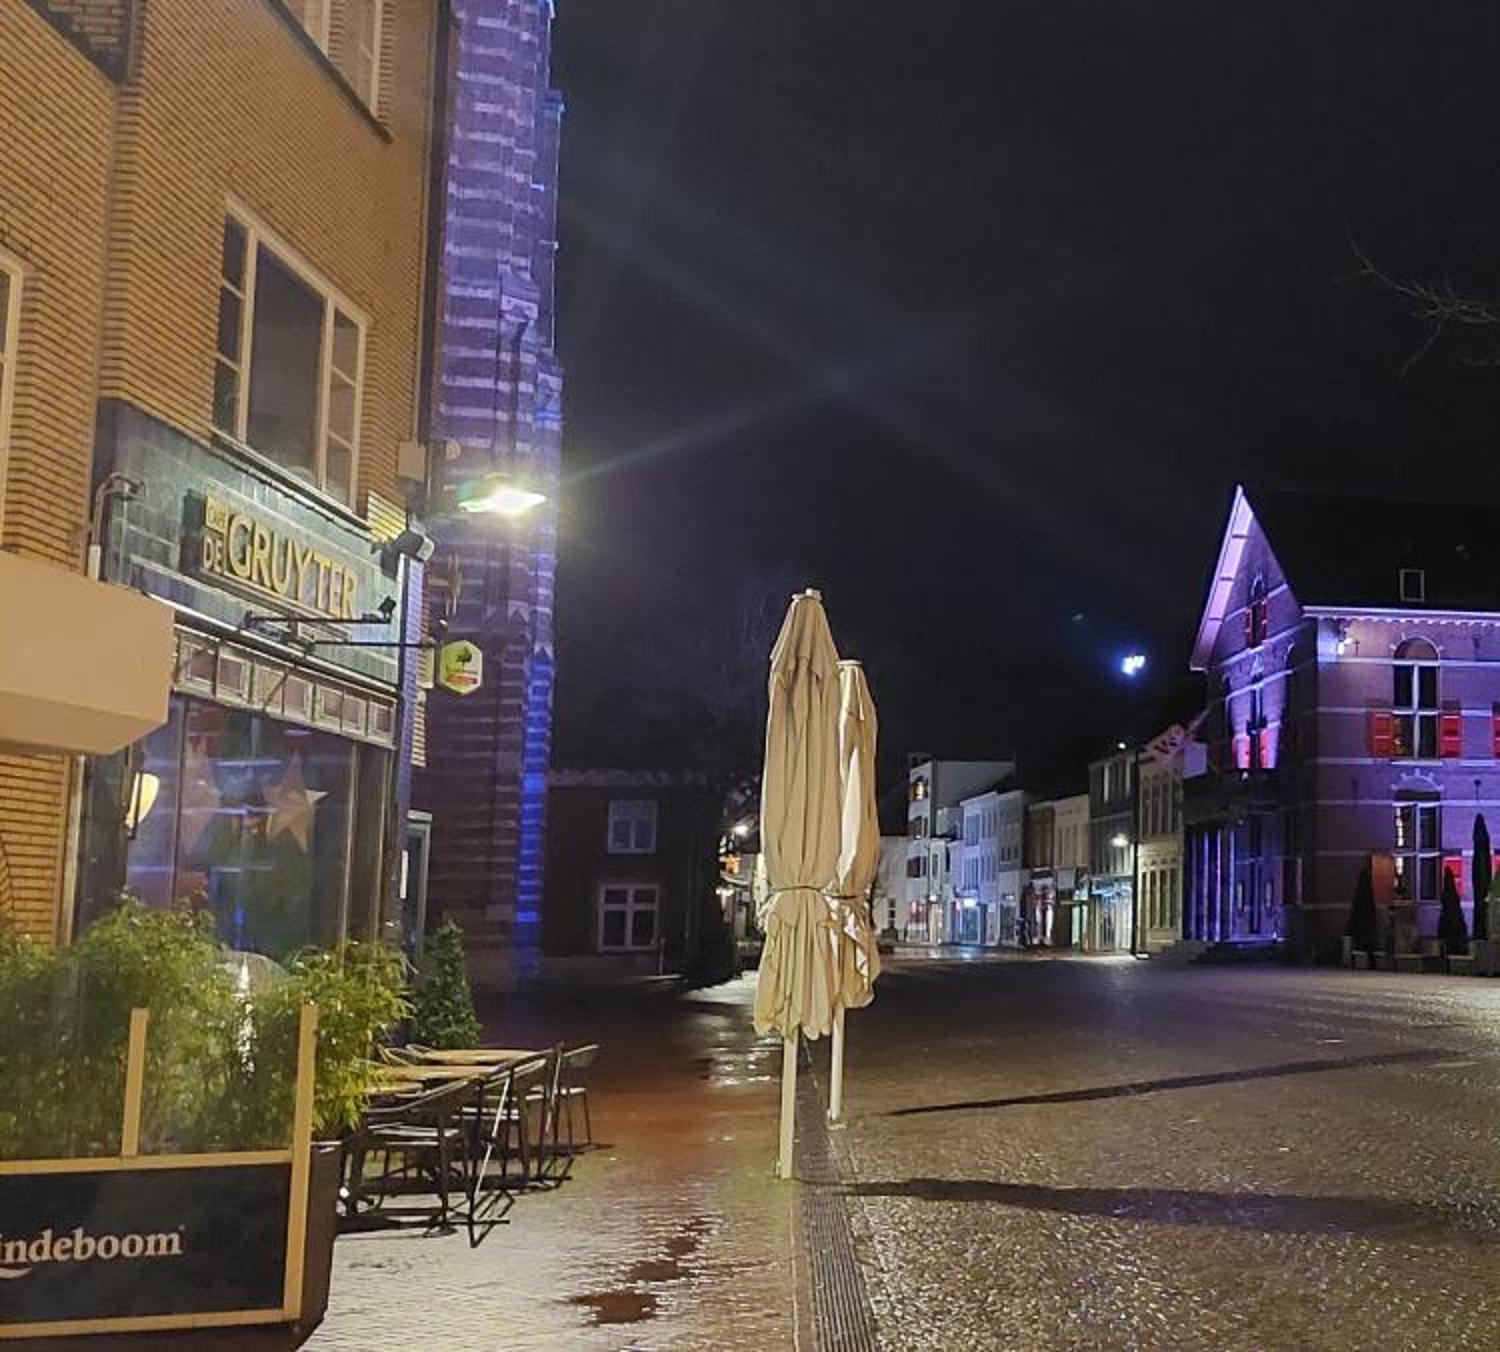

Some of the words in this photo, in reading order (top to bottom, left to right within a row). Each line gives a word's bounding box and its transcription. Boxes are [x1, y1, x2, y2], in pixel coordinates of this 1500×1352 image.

[203, 534, 225, 573] DE
[229, 514, 359, 620] GRUYTER
[0, 1227, 183, 1278] ndeboom
